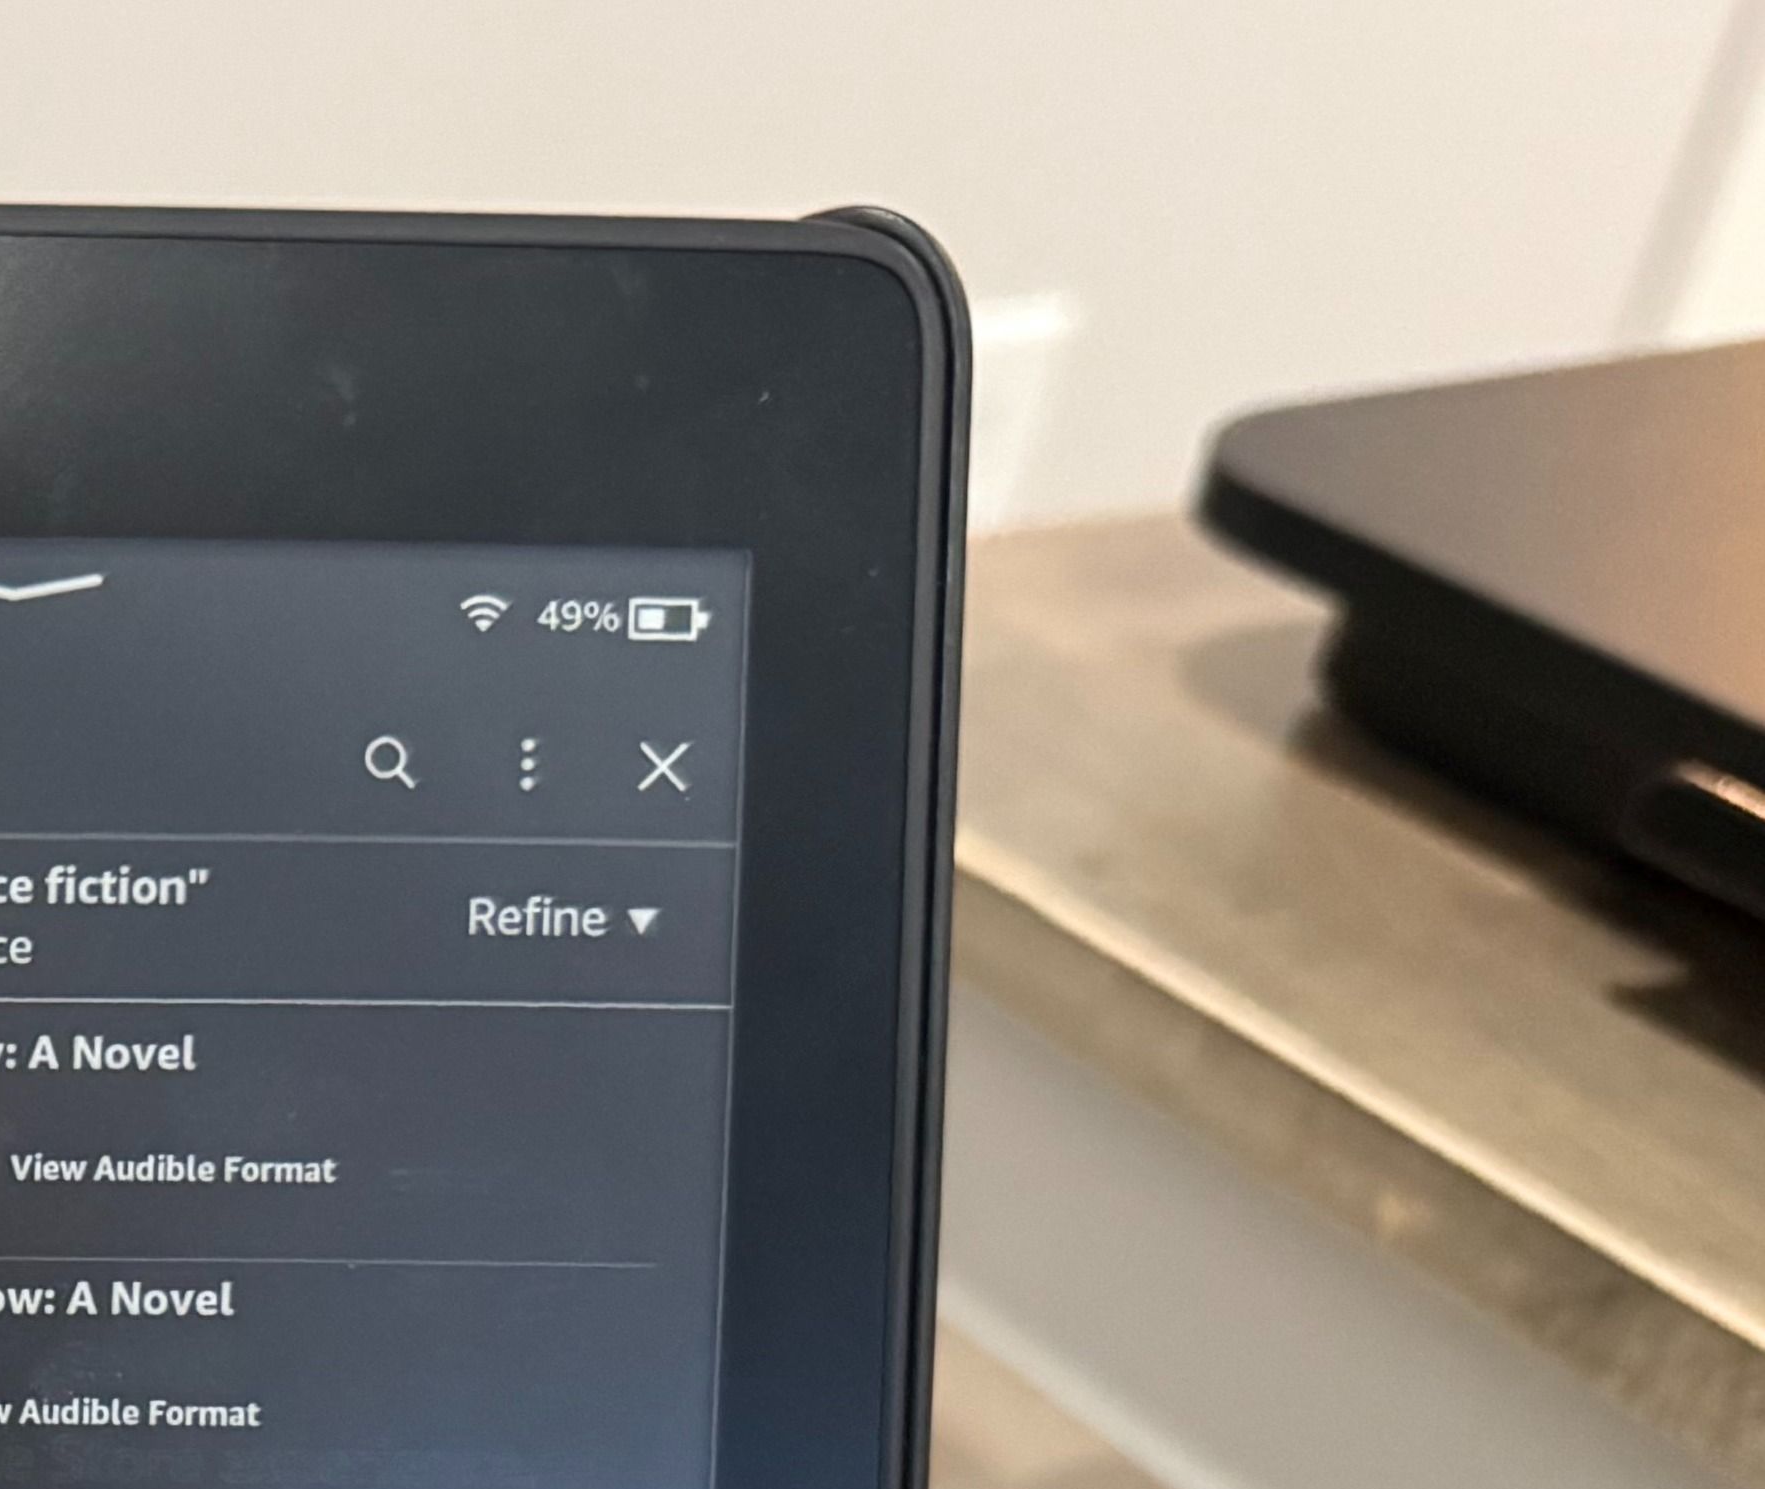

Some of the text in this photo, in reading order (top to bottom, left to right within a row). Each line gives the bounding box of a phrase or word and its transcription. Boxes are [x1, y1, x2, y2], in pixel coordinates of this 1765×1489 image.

[537, 599, 622, 633] 49%
[44, 864, 209, 905] fiction"
[468, 895, 608, 937] Refine
[27, 1034, 60, 1070] A
[73, 1034, 196, 1071] Novel
[10, 1152, 88, 1182] View
[92, 1153, 216, 1182] Audible
[224, 1156, 337, 1184] Format
[66, 1280, 98, 1315] A
[111, 1280, 235, 1316] Novel
[18, 1397, 140, 1426] Audible
[148, 1399, 261, 1427] Format
